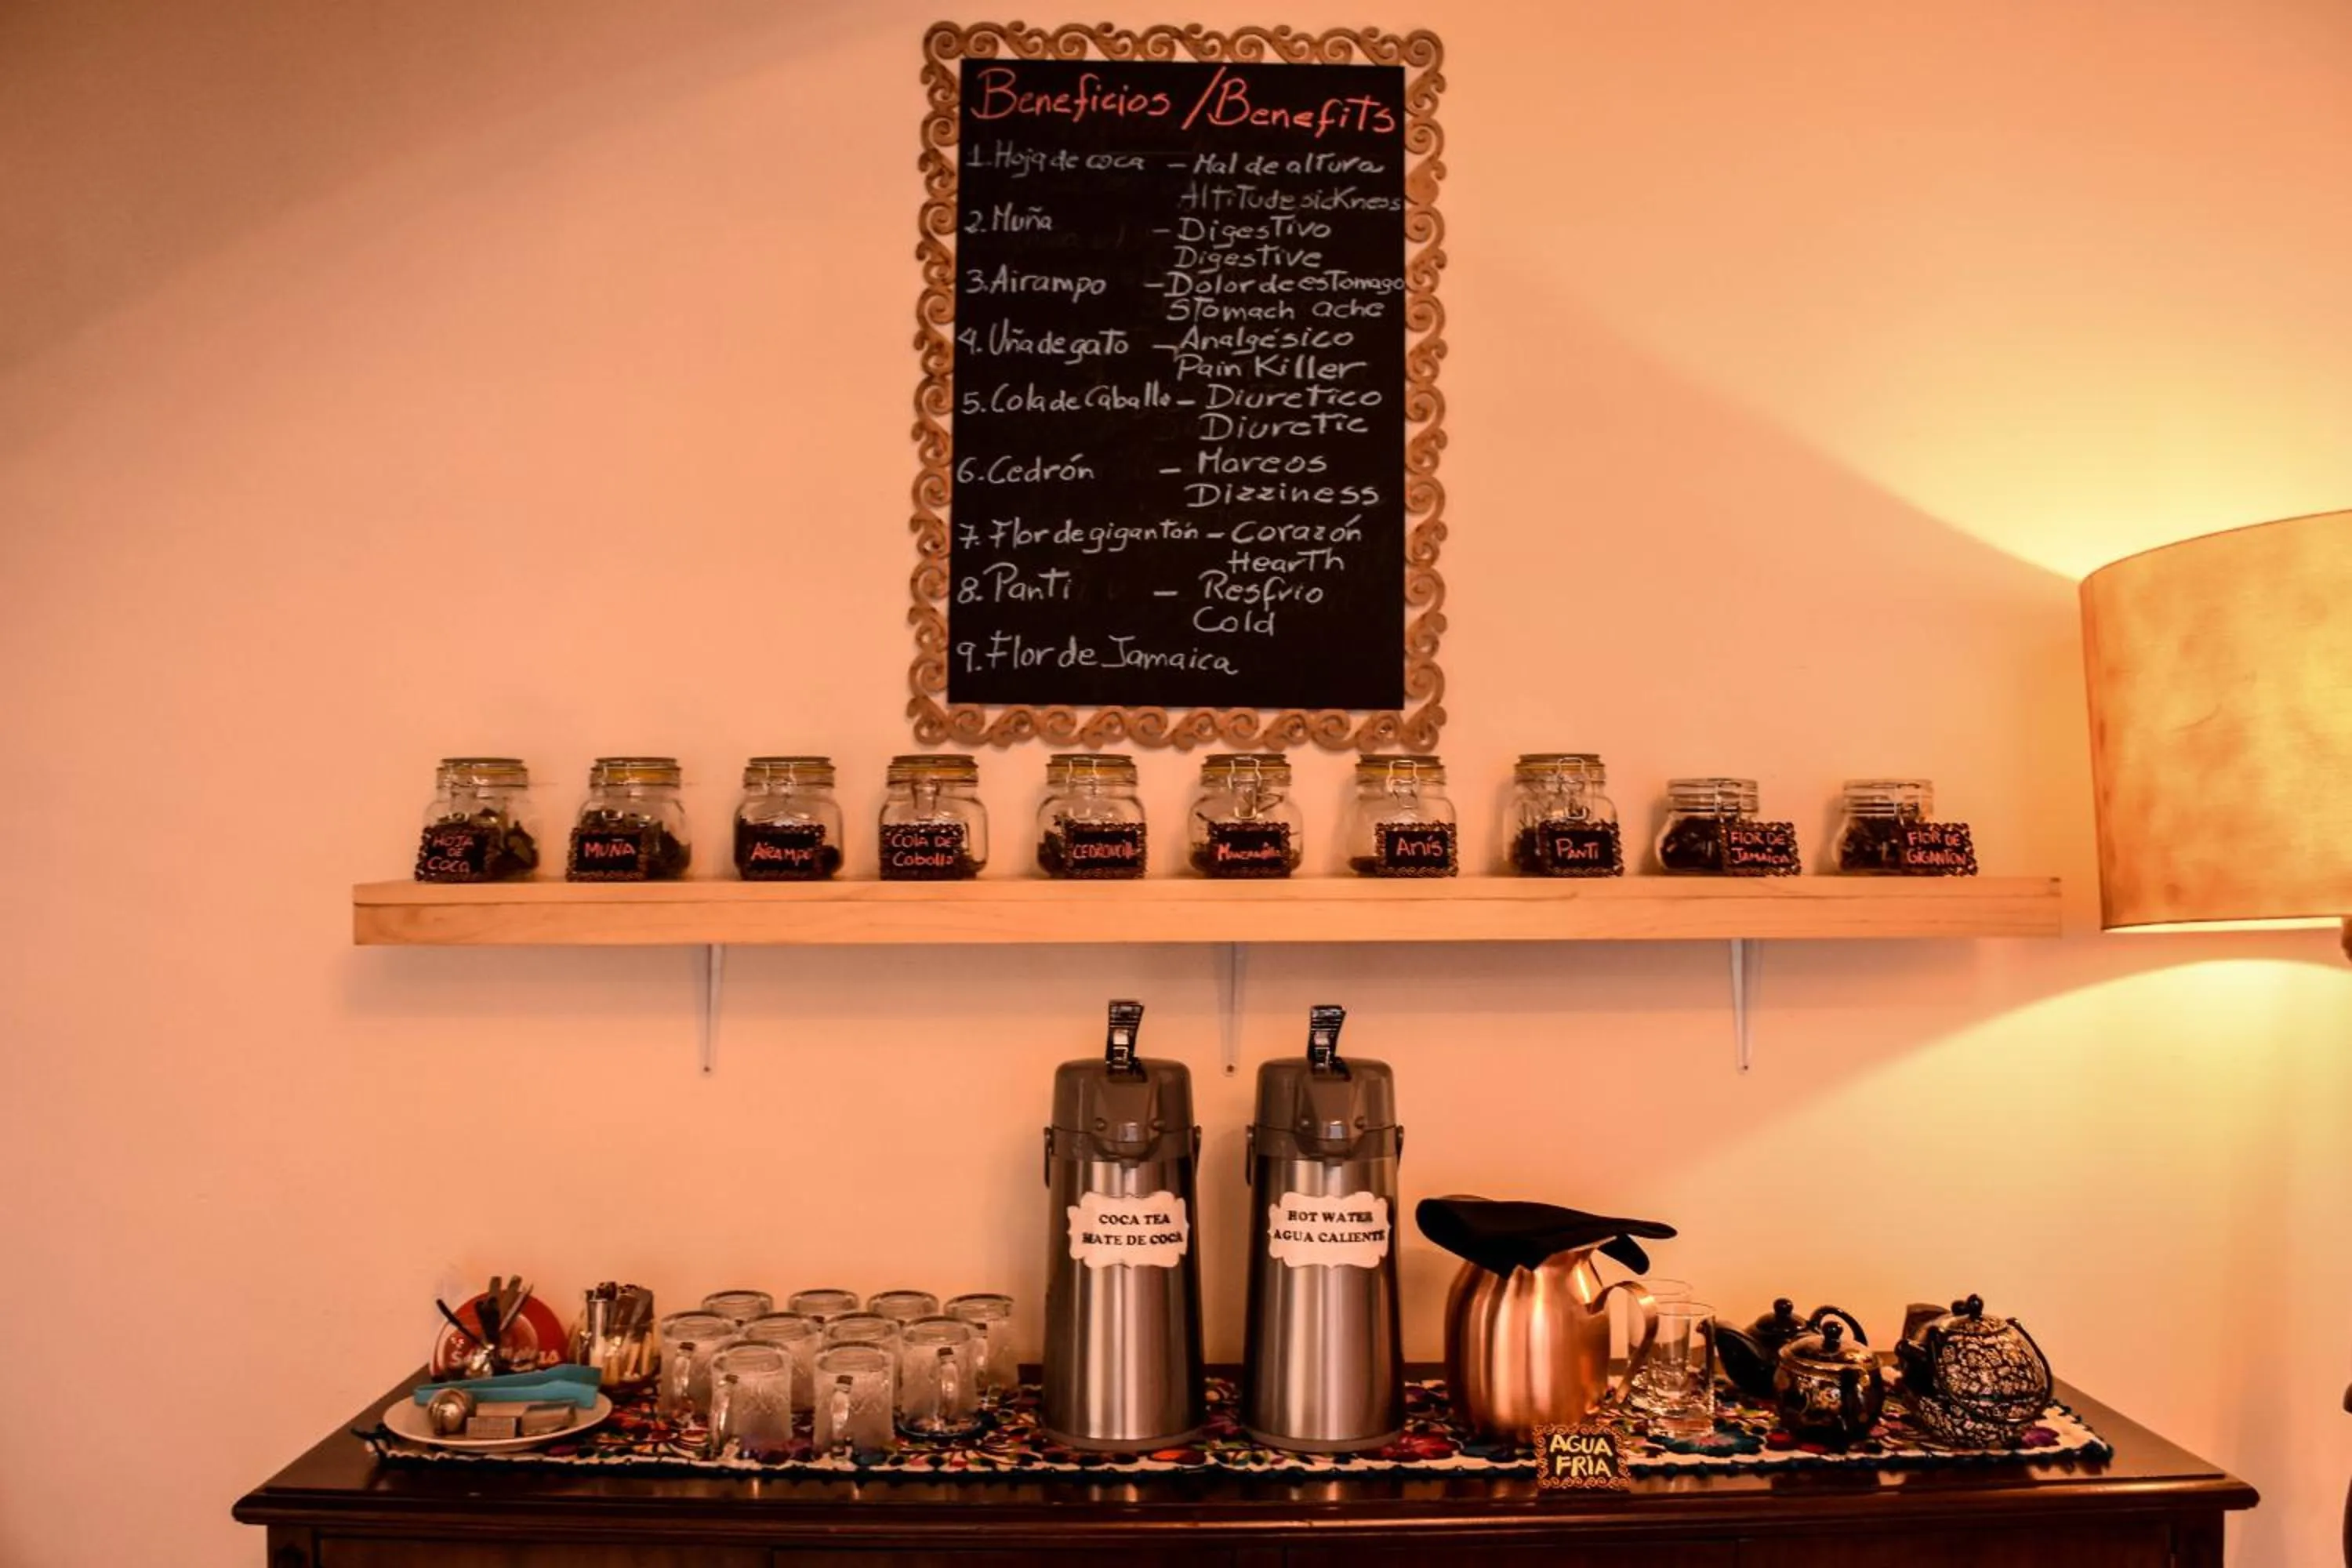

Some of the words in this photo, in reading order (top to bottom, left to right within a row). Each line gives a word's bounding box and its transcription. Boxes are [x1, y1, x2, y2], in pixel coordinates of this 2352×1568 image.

[970, 67, 1171, 123] Beneficios
[1086, 154, 1145, 170] coca
[1192, 152, 1237, 174] Mal
[1244, 156, 1279, 176] de
[992, 201, 1054, 232] Muña
[989, 263, 1107, 303] Airampo
[1258, 274, 1294, 294] de
[1311, 298, 1386, 318] ache
[989, 318, 1034, 355] Uña
[1036, 330, 1066, 354] de
[1174, 353, 1243, 382] Pain
[1254, 354, 1368, 379] Killer
[989, 382, 1046, 413] Cola
[1048, 390, 1082, 412] de
[1083, 379, 1172, 412] Caballo
[987, 452, 1095, 485] Cedrón
[1198, 446, 1328, 474] Mareos
[1183, 482, 1381, 508] Dizziness
[989, 517, 1051, 550] Flor
[1053, 518, 1084, 545] de
[1230, 514, 1363, 543] Corazón
[1192, 605, 1276, 636] Cold
[985, 630, 1056, 670] Flor
[1058, 635, 1098, 668] de
[1100, 634, 1240, 675] Jamaica
[1395, 835, 1444, 858] Anís
[1098, 1213, 1140, 1225] COCA
[1143, 1213, 1171, 1225] TEA
[1287, 1210, 1318, 1223] HOT
[1321, 1210, 1374, 1223] WATER
[1082, 1232, 1123, 1246] MATE
[1126, 1234, 1148, 1246] DE
[1149, 1231, 1184, 1245] COCA
[1273, 1229, 1315, 1243] AGUA
[1317, 1228, 1385, 1243] CALIENTE
[1549, 1433, 1613, 1457] AGUA
